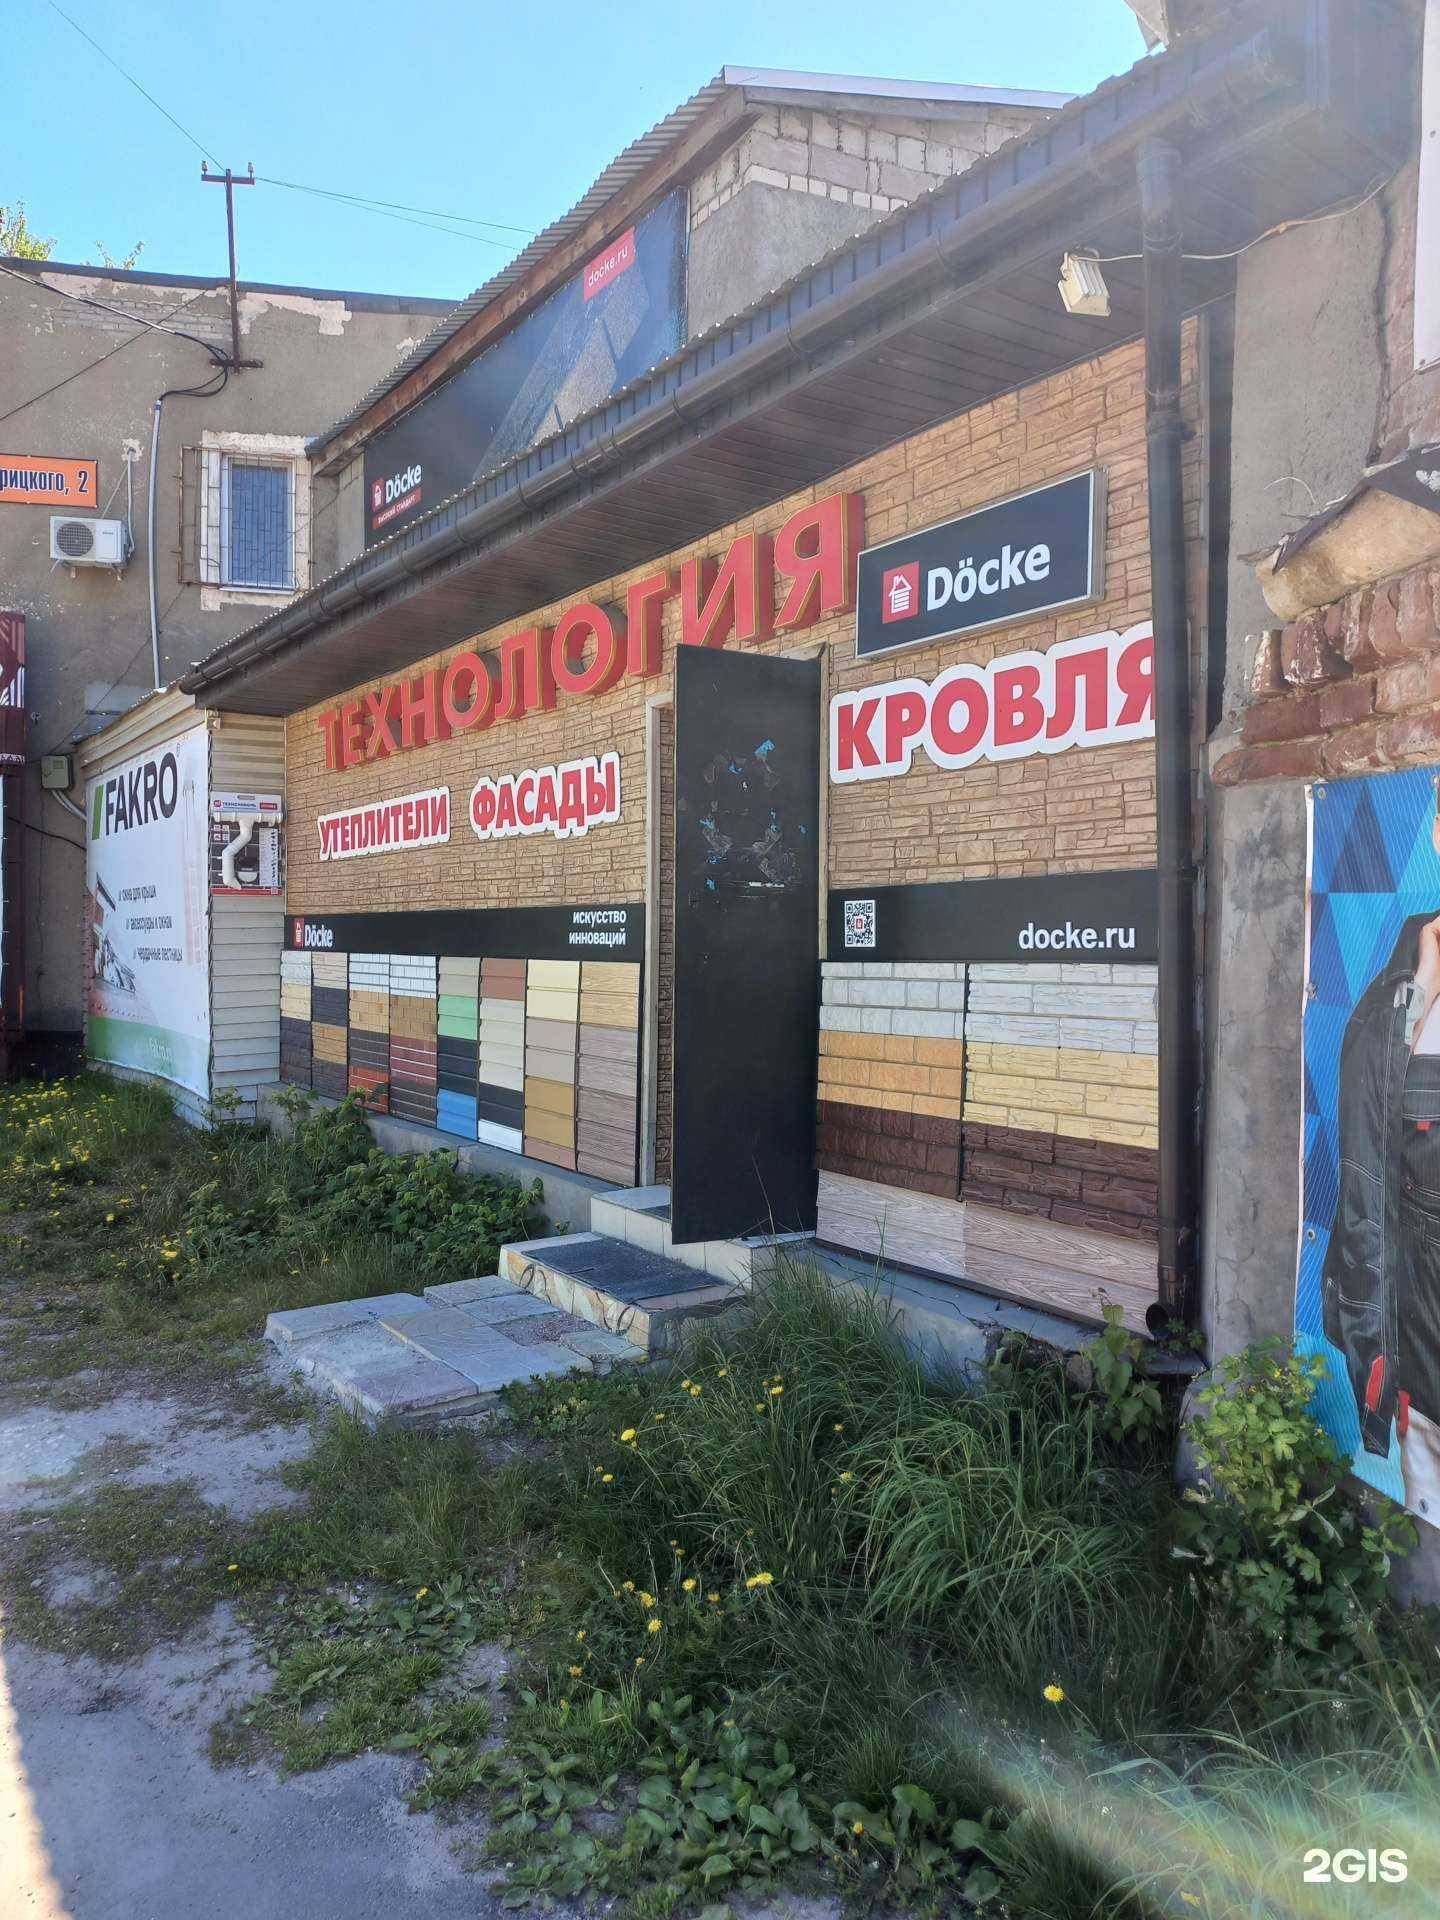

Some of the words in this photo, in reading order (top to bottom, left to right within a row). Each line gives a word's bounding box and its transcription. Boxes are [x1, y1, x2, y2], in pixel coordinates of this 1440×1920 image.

[588, 246, 628, 287] docke.ru
[78, 470, 88, 493] 2
[385, 464, 422, 504] Döcke
[926, 543, 1050, 611] Döcke
[318, 492, 864, 770] ТЕХНОЛОГИЯ
[837, 636, 1156, 771] КРОВЛЯ
[105, 752, 178, 836] FAKRO
[472, 761, 615, 831] ФАСАДЫ
[319, 794, 447, 854] УТЕПЛИТЕЛИ
[304, 924, 333, 948] Döcke
[569, 928, 626, 948] инноваций
[573, 910, 627, 928] искусство
[1018, 922, 1136, 949] docke.ru
